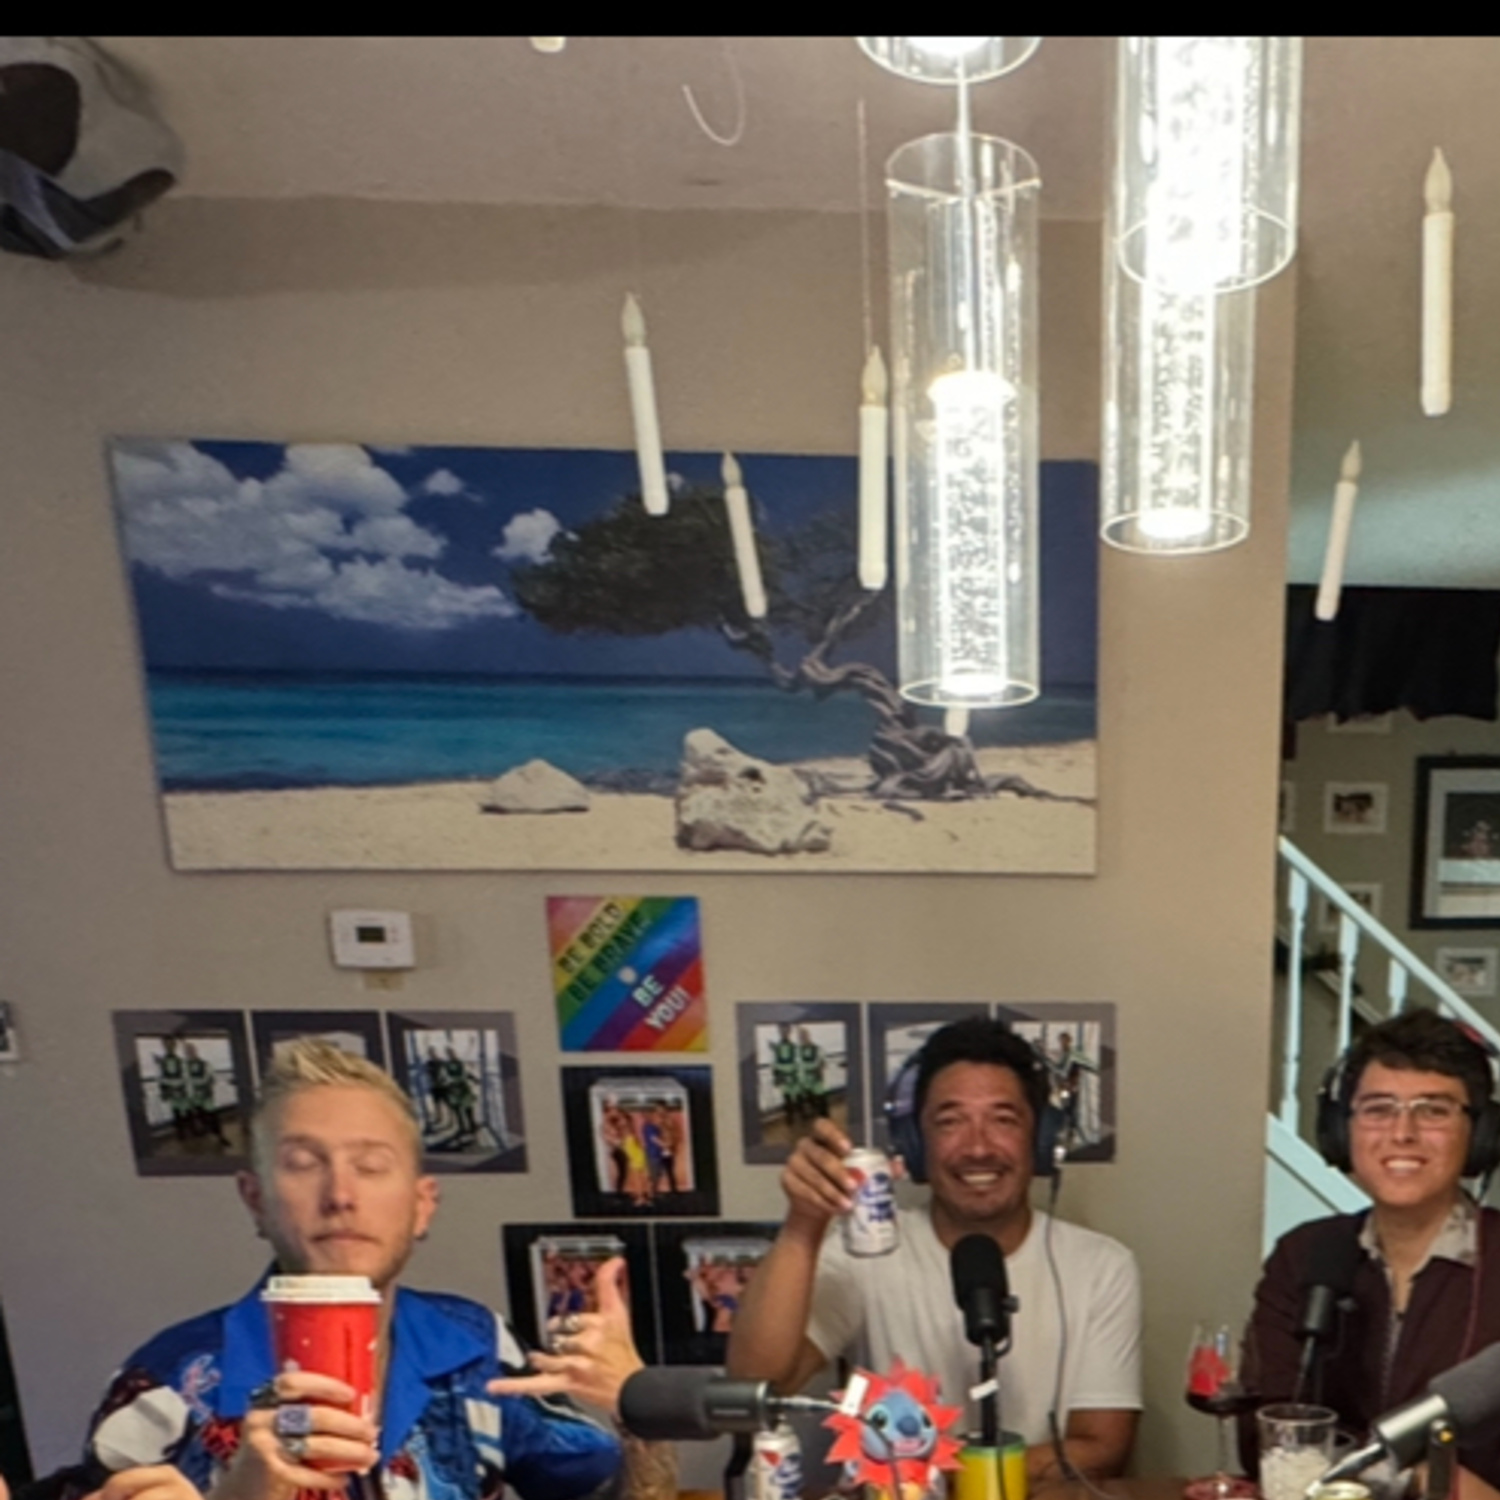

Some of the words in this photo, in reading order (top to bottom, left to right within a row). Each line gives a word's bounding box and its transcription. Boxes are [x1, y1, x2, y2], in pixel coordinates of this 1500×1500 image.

[579, 901, 623, 950] BOLD
[591, 908, 655, 975] BRAVE
[632, 974, 665, 1007] BE
[644, 985, 690, 1032] YOU!
